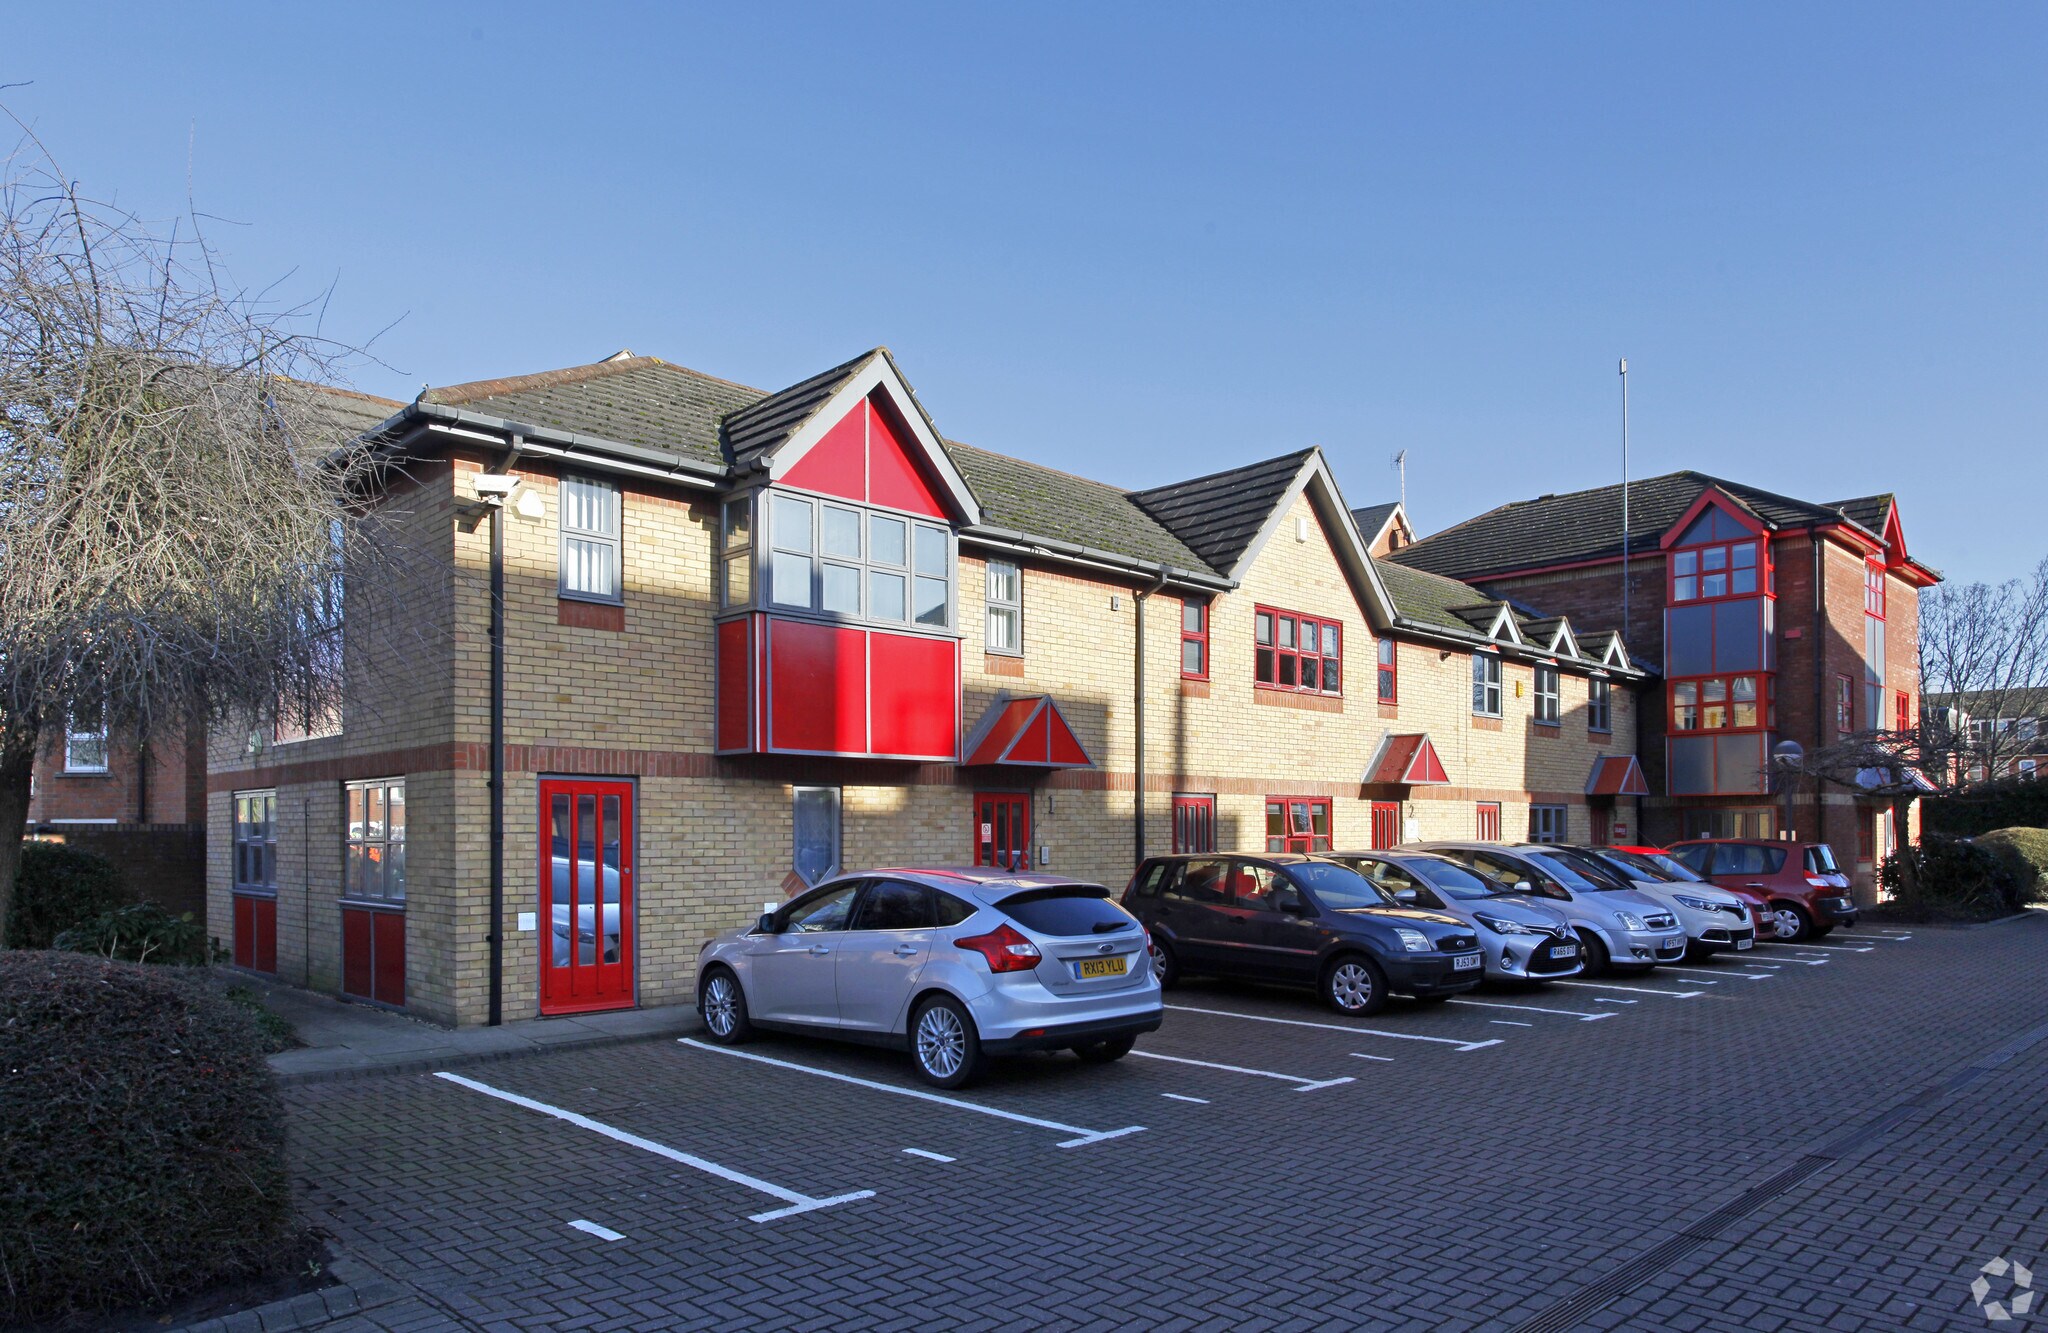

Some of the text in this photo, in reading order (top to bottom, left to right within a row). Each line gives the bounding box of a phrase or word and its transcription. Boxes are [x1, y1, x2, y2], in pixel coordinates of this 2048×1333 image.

[1048, 795, 1054, 814] 1
[1408, 804, 1415, 818] 2
[1083, 959, 1124, 975] RX13 YLU
[1456, 957, 1470, 968] RJ53
